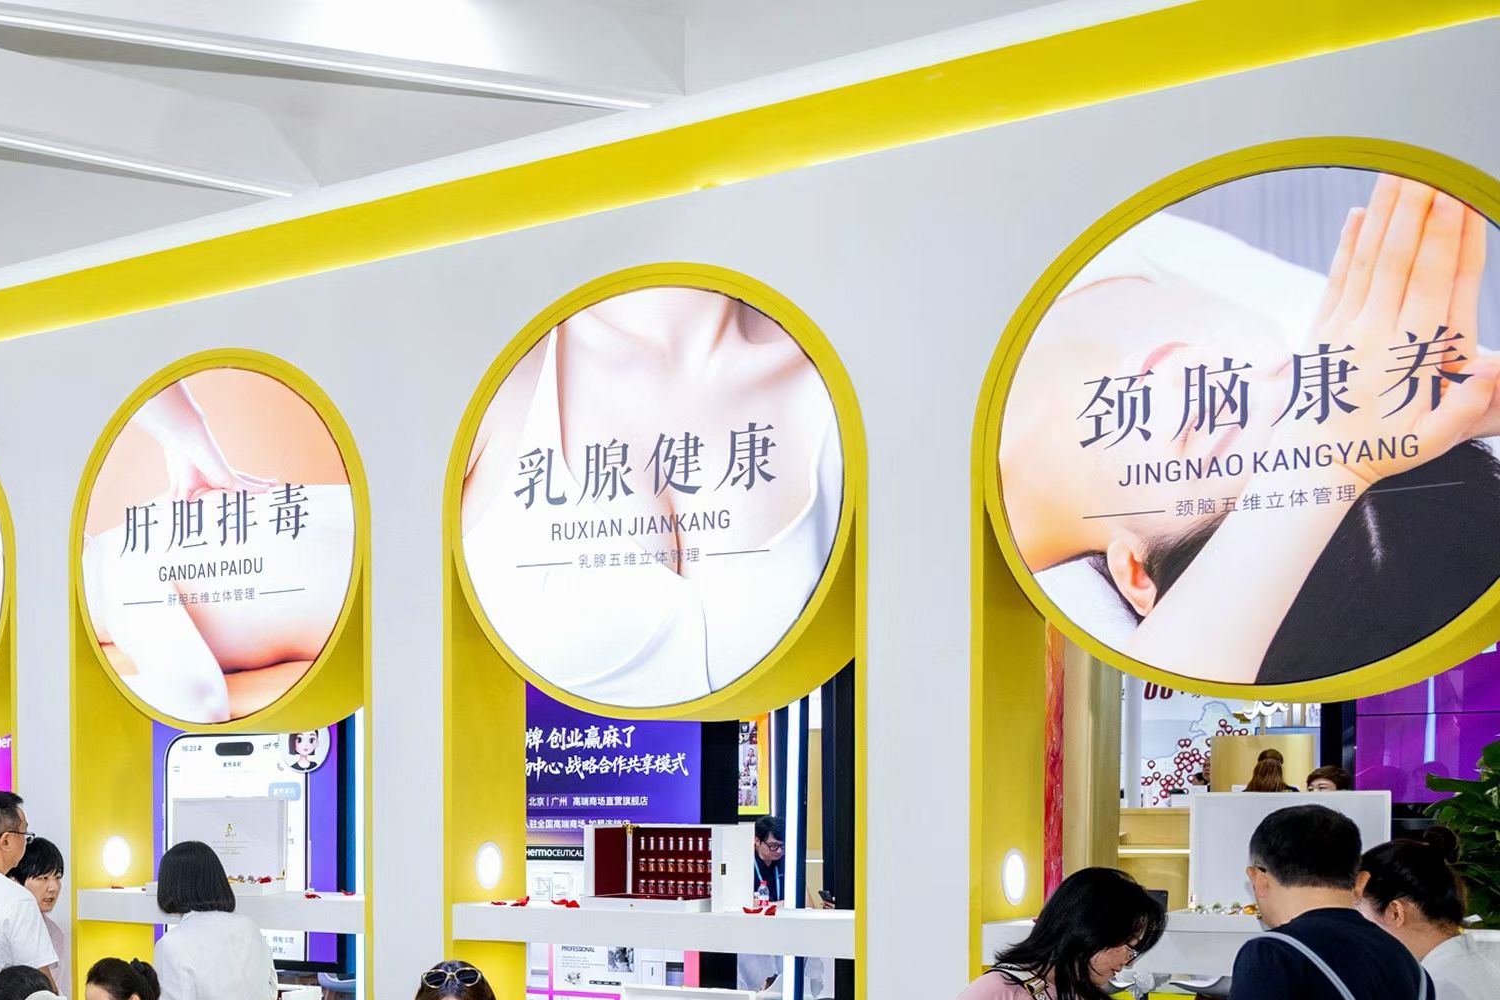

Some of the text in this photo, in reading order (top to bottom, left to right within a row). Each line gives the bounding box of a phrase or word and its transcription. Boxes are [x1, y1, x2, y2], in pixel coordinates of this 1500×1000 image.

[1076, 325, 1475, 450] 颈脑康养
[514, 422, 777, 509] 乳腺健康
[1118, 434, 1420, 487] JINGNAO KANGYANG
[1175, 484, 1357, 518] 颈脑五维立体管理
[119, 483, 309, 558] 肝胆排毒
[551, 509, 731, 541] RUXIAN JIANKANG
[158, 557, 264, 582] GANDAN PAIDU
[578, 547, 700, 569] 乳腺五维立体管理
[167, 587, 256, 606] 肝胆五维立体管理
[546, 725, 636, 751] 创业赢麻了
[565, 753, 689, 780] 战略合作共享模式
[525, 819, 586, 829] 驻全国高端商场
